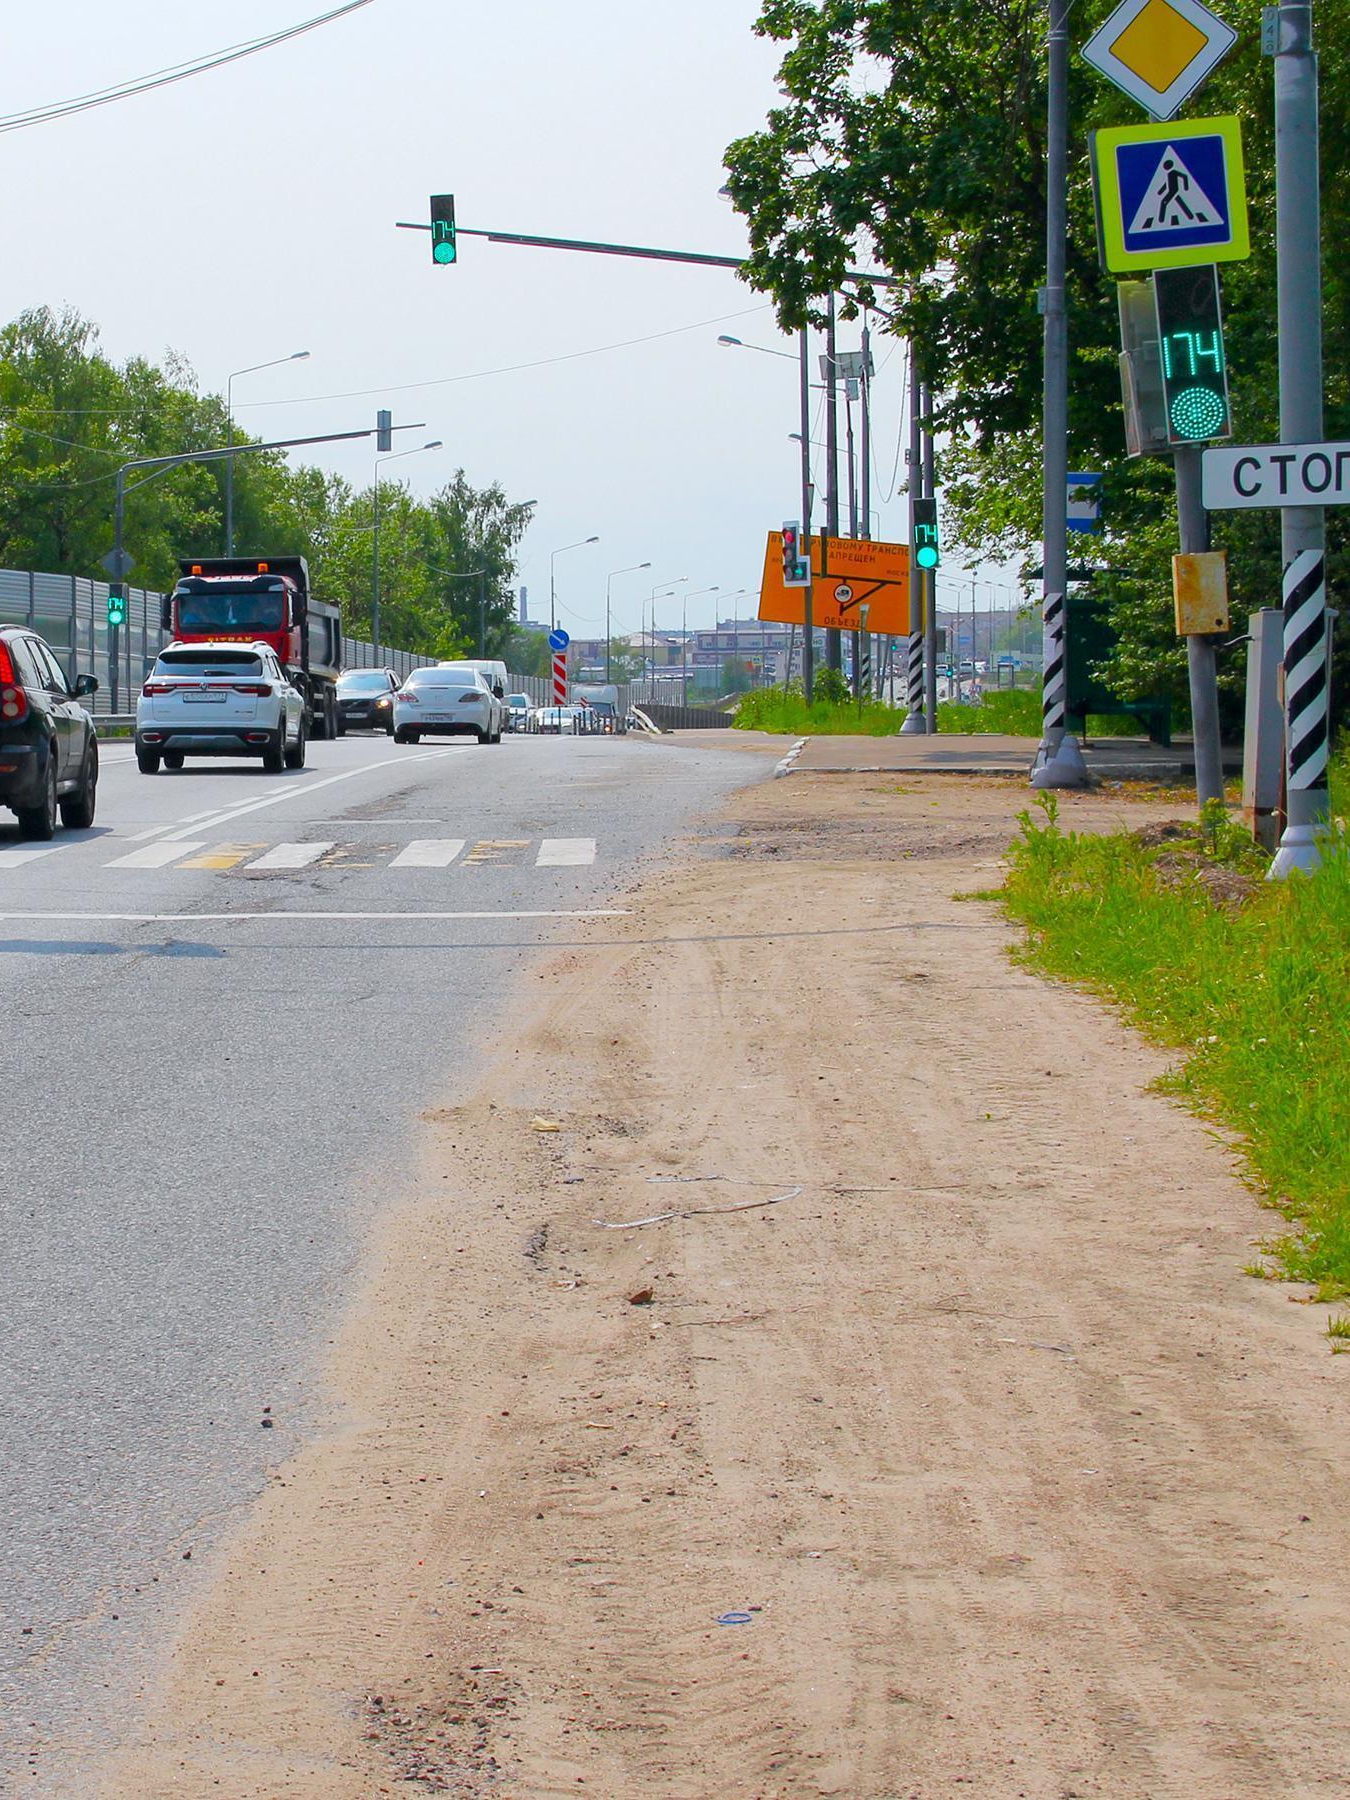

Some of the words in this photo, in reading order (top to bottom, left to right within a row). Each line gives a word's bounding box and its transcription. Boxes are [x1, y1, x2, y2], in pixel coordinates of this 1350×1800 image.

[1163, 331, 1221, 379] 174
[828, 550, 876, 564] АПРЕЩЕН
[867, 544, 910, 557] ТРАНСПО
